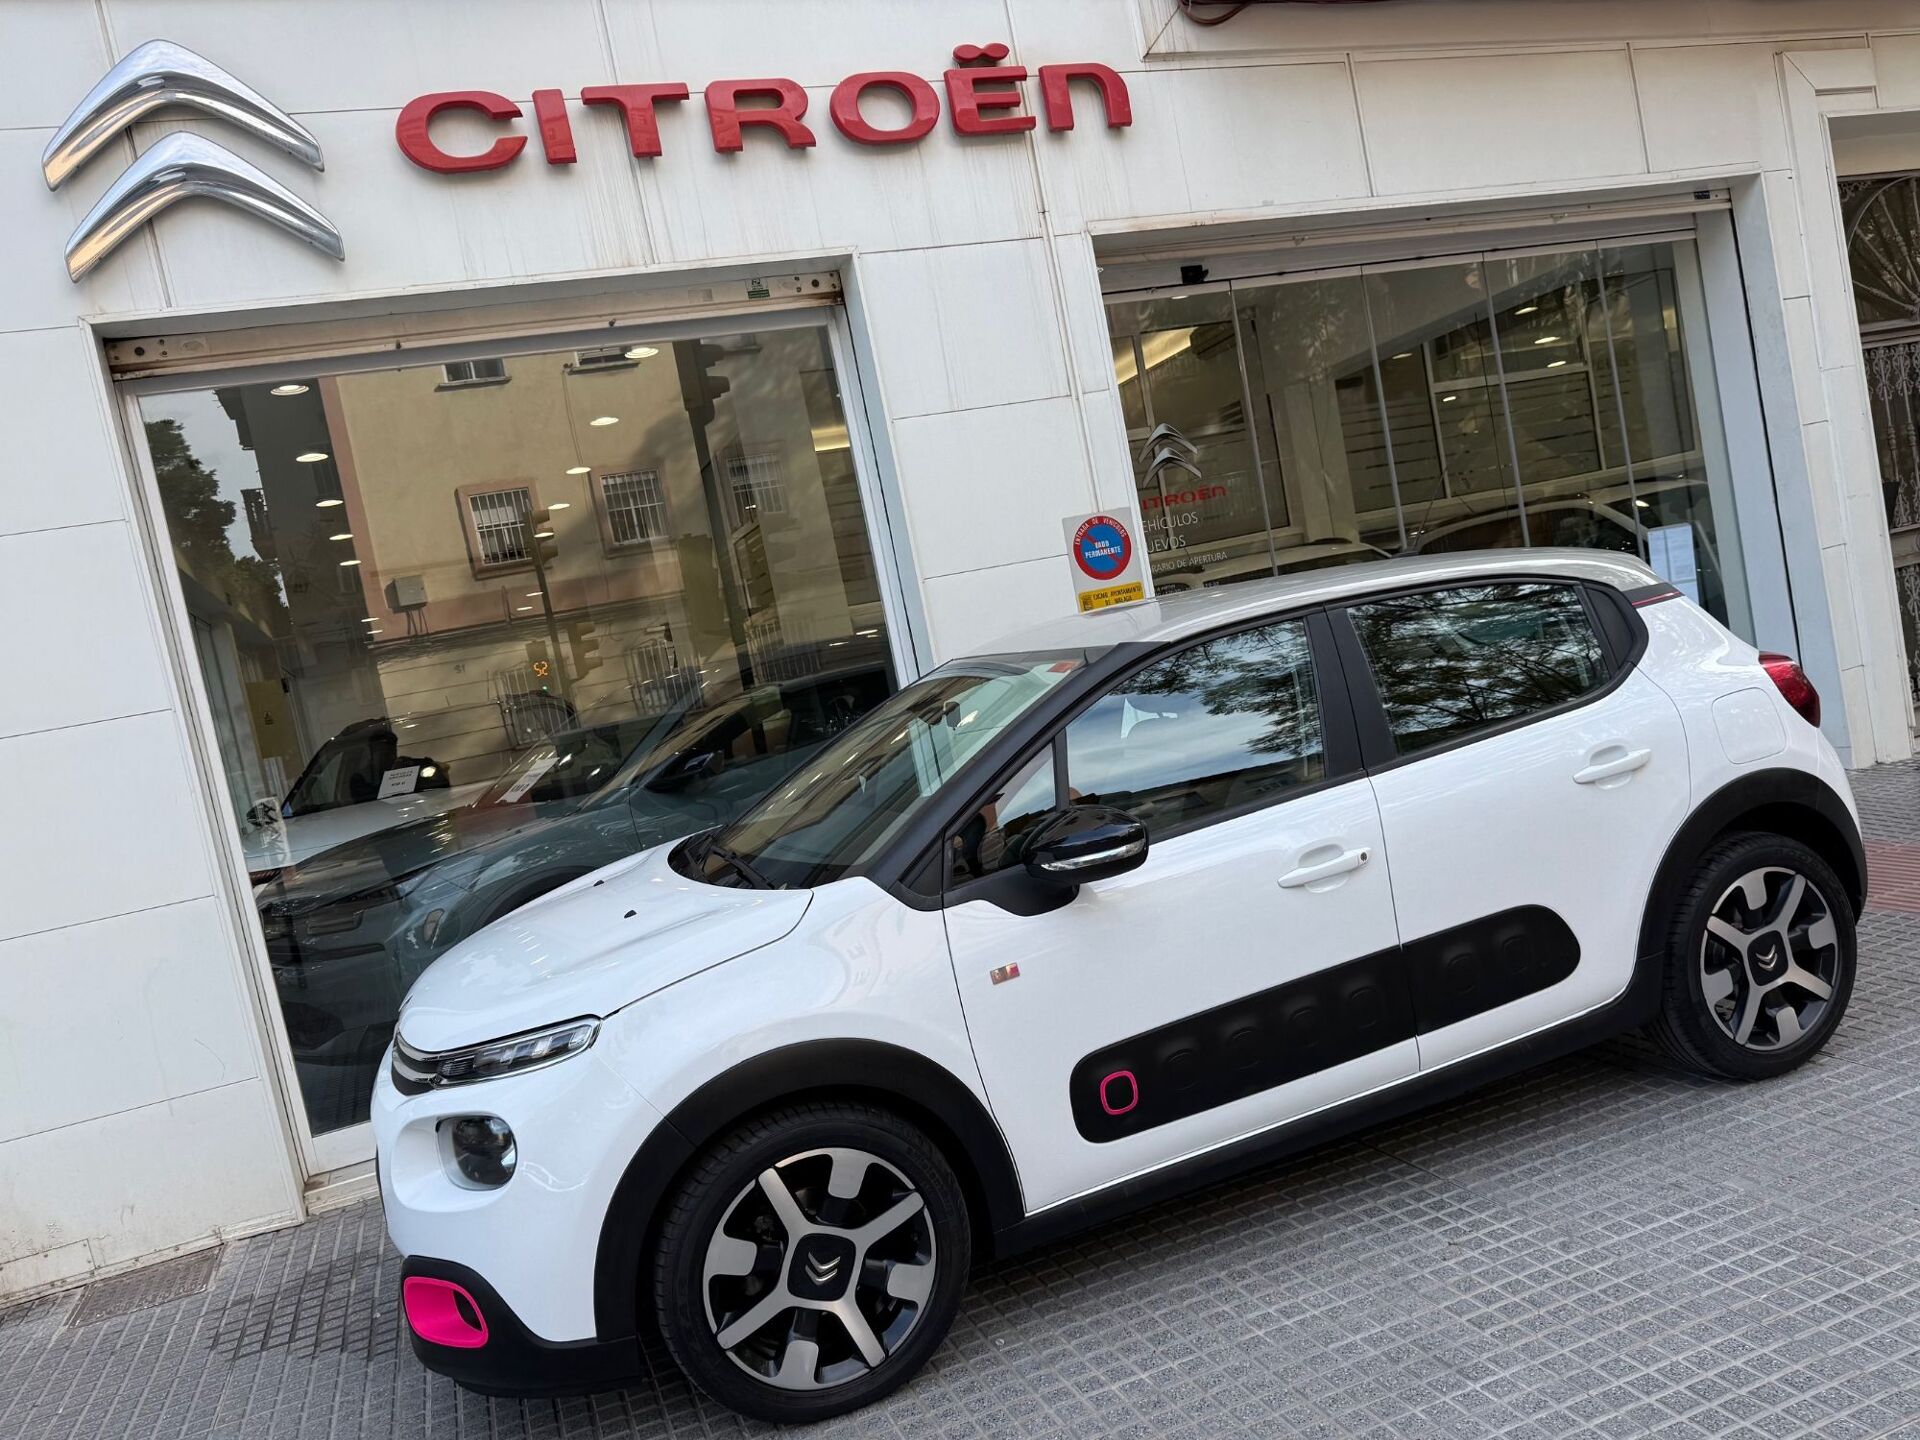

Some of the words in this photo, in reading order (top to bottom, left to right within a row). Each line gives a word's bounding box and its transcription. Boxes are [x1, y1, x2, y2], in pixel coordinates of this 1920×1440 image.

[1141, 485, 1227, 510] ITROËN
[1142, 511, 1198, 533] EHÍCULOS
[1085, 546, 1122, 559] PERMANENTE
[1094, 540, 1110, 549] VADO
[1147, 535, 1186, 553] UEVOS
[1152, 562, 1175, 573] RARIO
[1189, 551, 1228, 566] APERTURA
